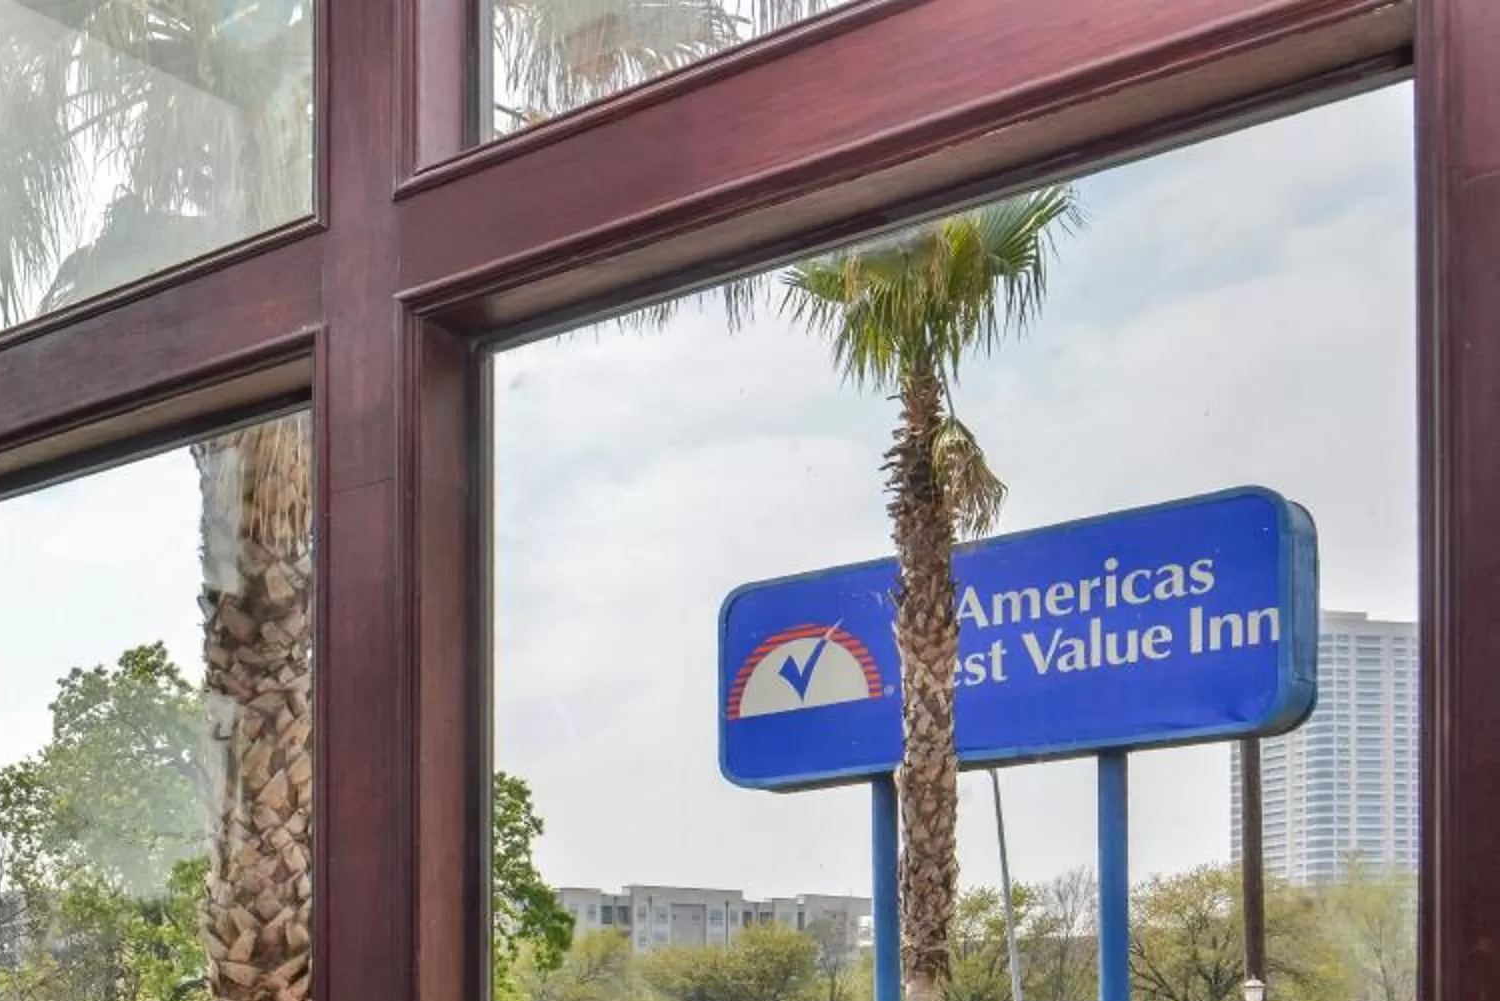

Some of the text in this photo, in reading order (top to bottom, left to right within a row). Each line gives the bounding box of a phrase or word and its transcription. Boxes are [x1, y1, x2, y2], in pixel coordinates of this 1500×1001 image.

[956, 557, 1216, 629] Americas
[1021, 616, 1174, 675] Value
[1190, 607, 1281, 654] Inn
